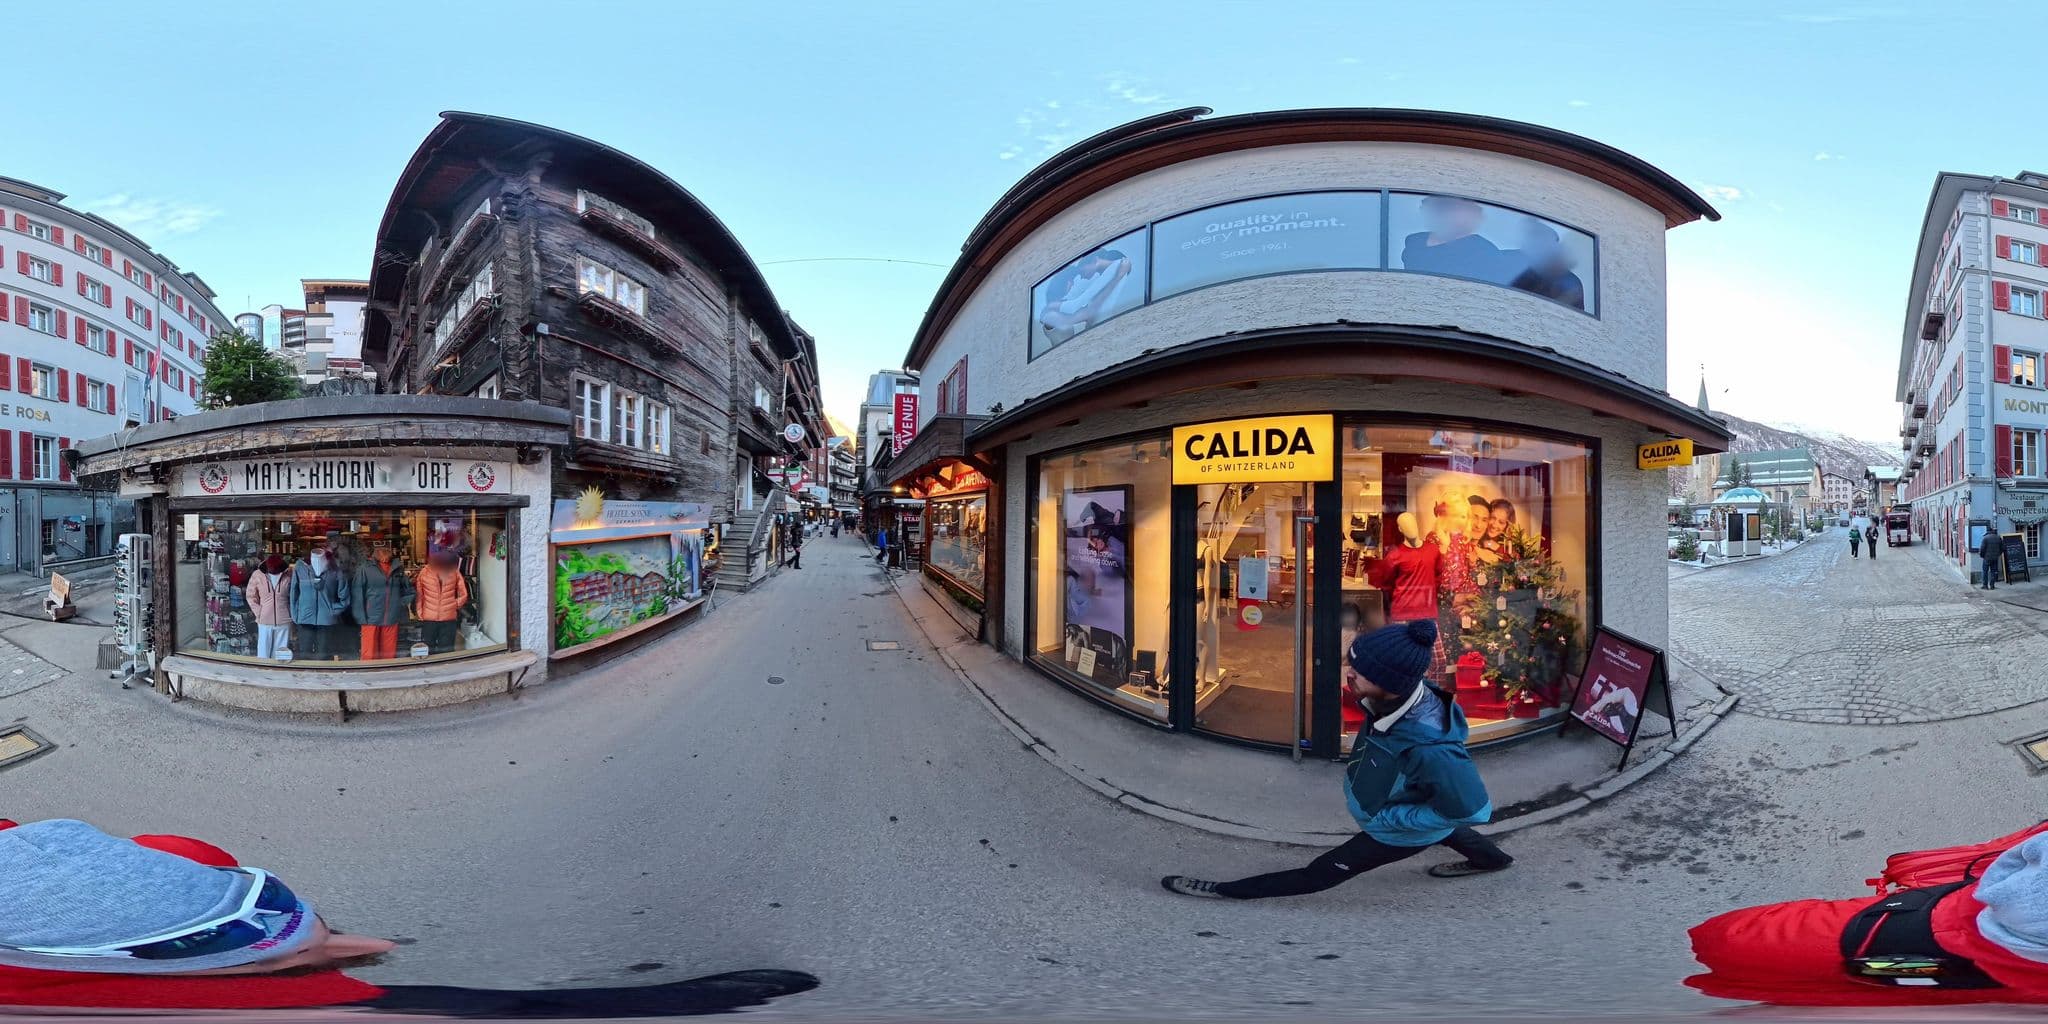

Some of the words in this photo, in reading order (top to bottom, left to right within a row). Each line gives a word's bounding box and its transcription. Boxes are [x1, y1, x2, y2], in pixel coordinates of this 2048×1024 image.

[1205, 213, 1283, 233] Quality
[1291, 211, 1309, 220] in
[1181, 231, 1233, 250] every
[1238, 217, 1346, 237] moment.
[1221, 247, 1256, 259] Since
[16, 406, 51, 422] ROSA
[902, 396, 914, 446] AVENUE
[1185, 427, 1315, 461] CALIDA
[1642, 444, 1681, 459] CALIDA
[396, 461, 452, 489] ORT
[1201, 464, 1213, 473] OF
[1217, 461, 1295, 472] SWITZERLAND
[1589, 711, 1611, 728] CALIDA
